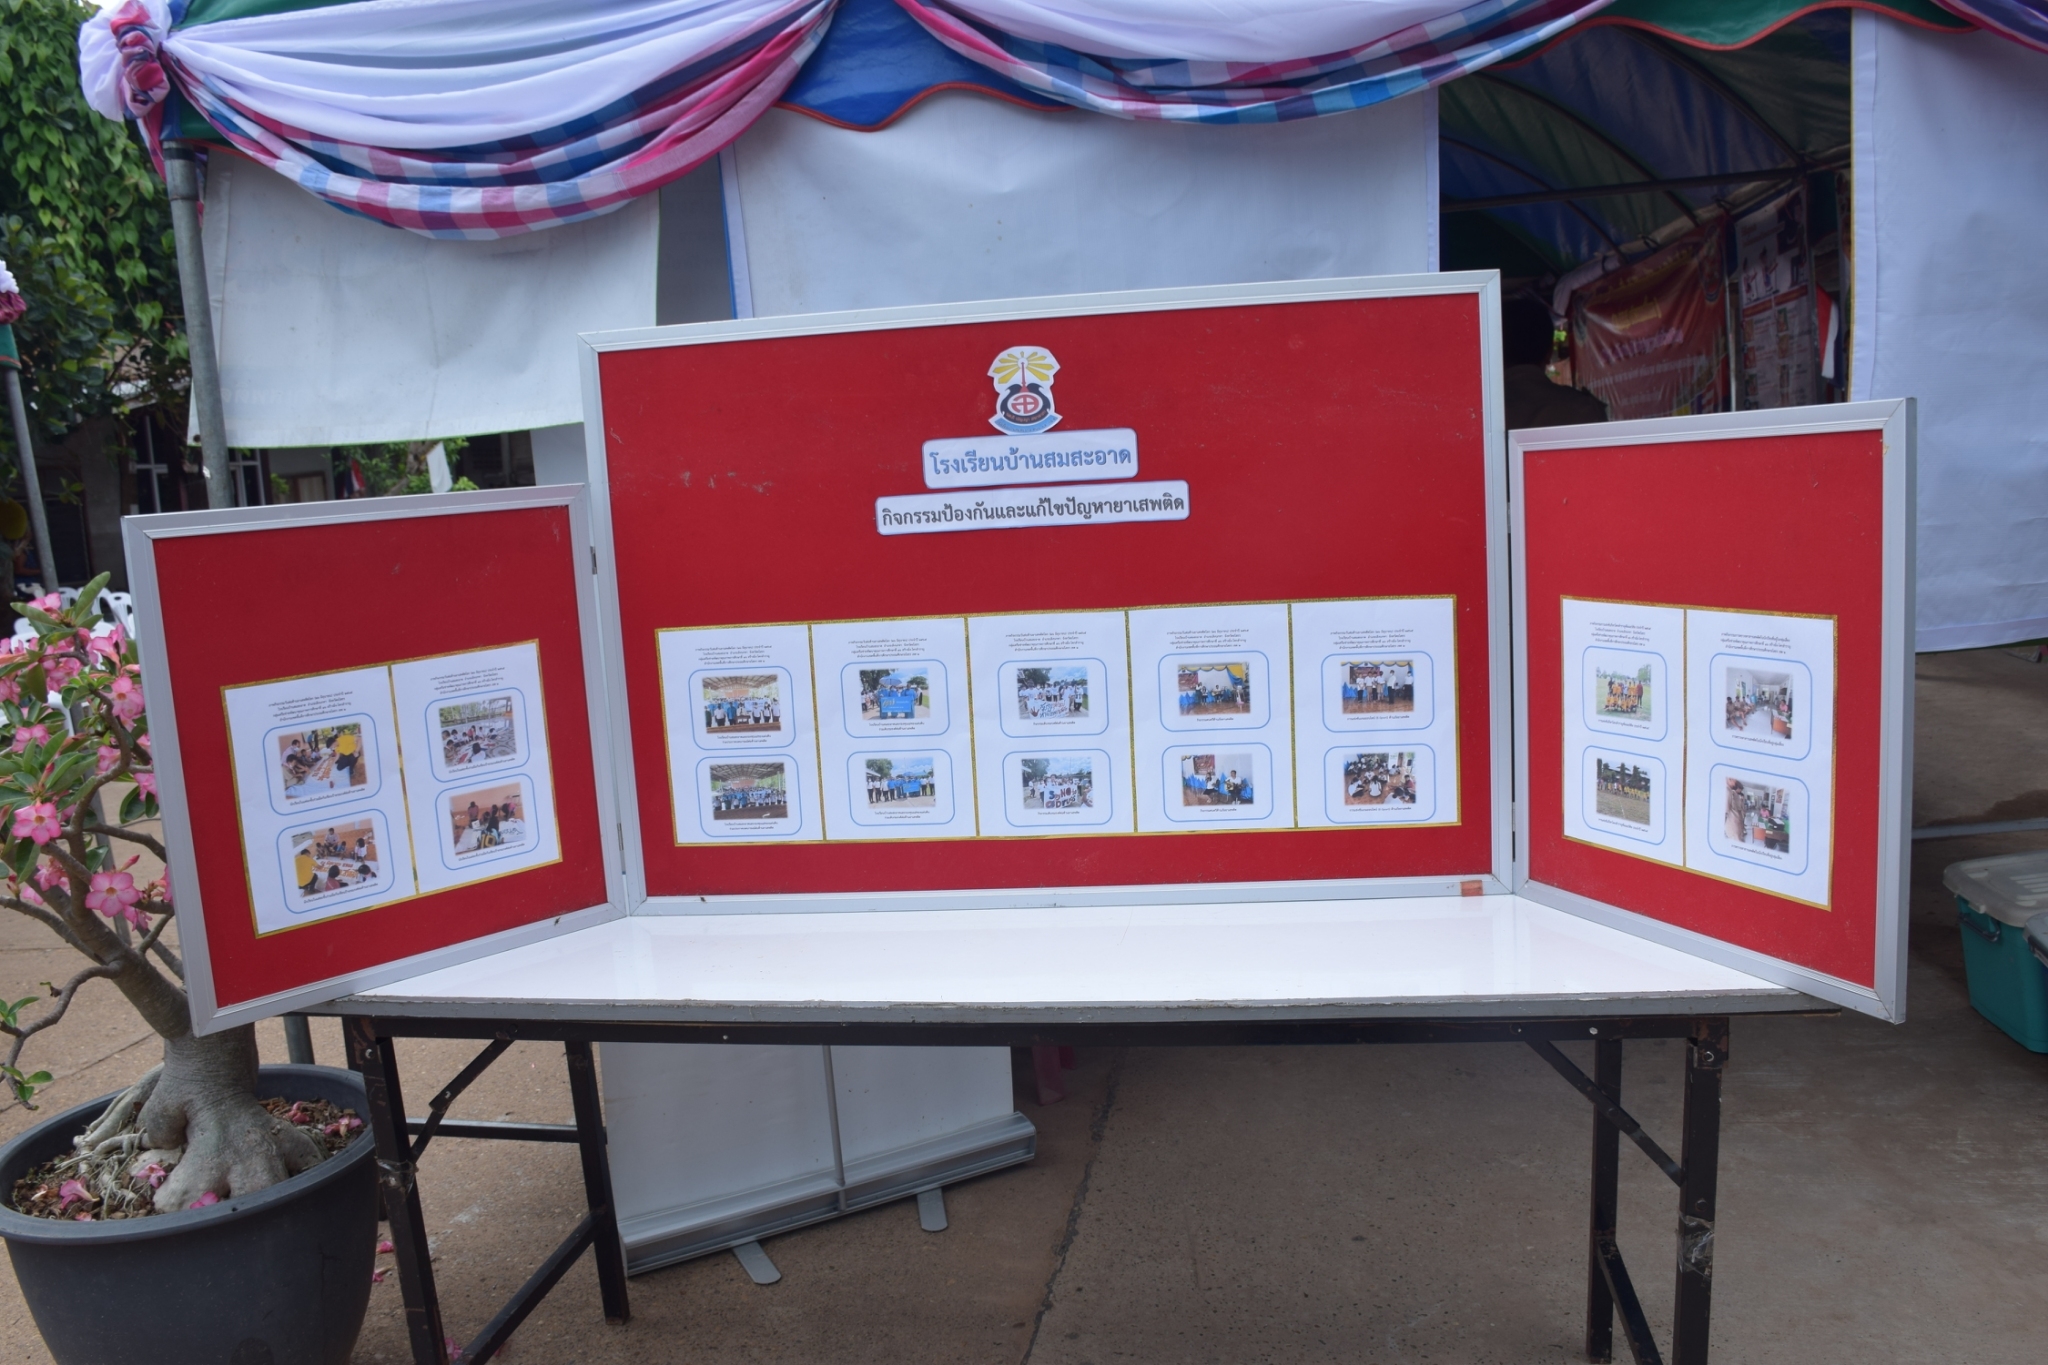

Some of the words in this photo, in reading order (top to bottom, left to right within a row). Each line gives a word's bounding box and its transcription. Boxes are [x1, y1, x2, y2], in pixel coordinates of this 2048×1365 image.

[929, 447, 1131, 475] โรงเรียนบ้านสมสะอาด
[882, 492, 1185, 526] กิจกรรมป้องกันและแก้ไขปัญหายาเสพติด
